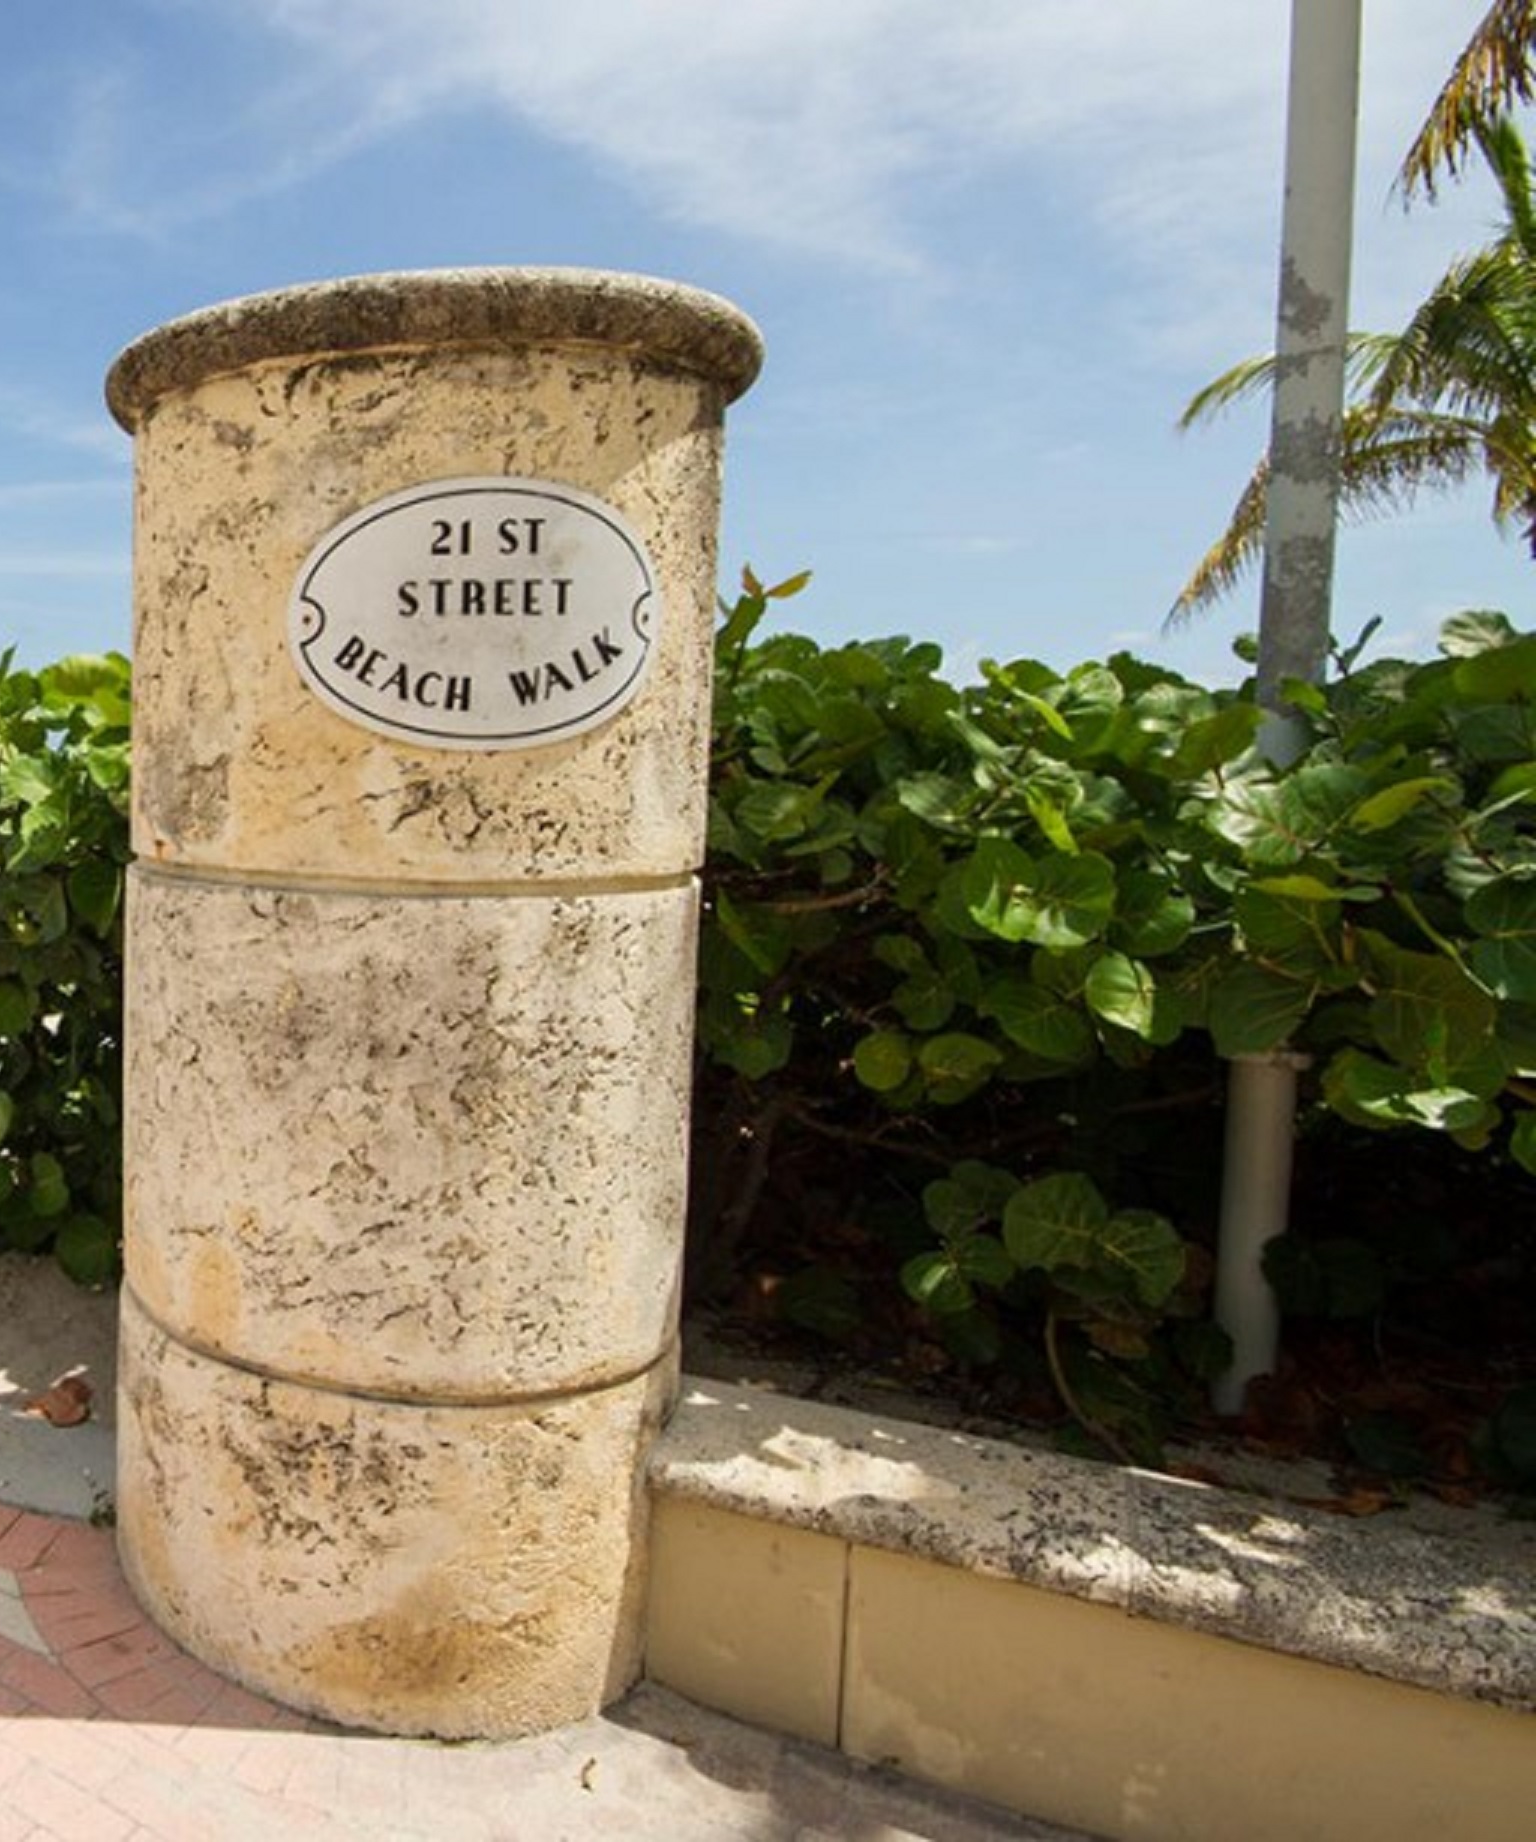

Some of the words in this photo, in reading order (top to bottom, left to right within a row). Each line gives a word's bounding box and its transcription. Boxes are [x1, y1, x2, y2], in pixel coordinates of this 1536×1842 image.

[430, 519, 472, 556] 21
[498, 517, 547, 555] ST
[397, 578, 574, 617] STREET
[333, 634, 472, 712] BEACH
[508, 625, 625, 707] WALK
